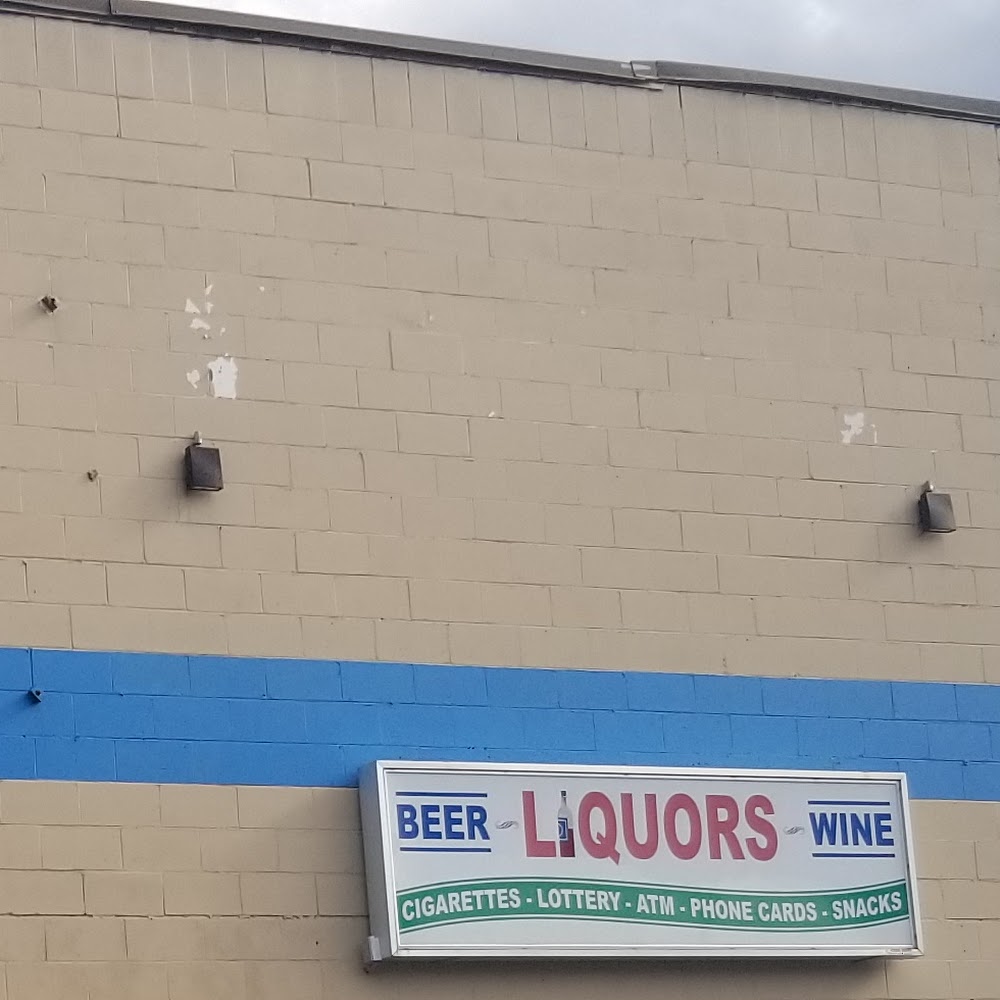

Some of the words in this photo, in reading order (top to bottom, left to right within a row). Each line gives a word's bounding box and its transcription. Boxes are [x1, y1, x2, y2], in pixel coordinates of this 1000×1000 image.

[396, 804, 490, 840] BEER
[809, 812, 895, 846] WINE
[402, 888, 520, 921] CIGARETTES
[537, 888, 620, 911] LOTTERY
[637, 893, 674, 916] ATM
[690, 898, 753, 921] PHONE
[758, 901, 818, 923] CARDS
[832, 891, 902, 920] SNACKS
